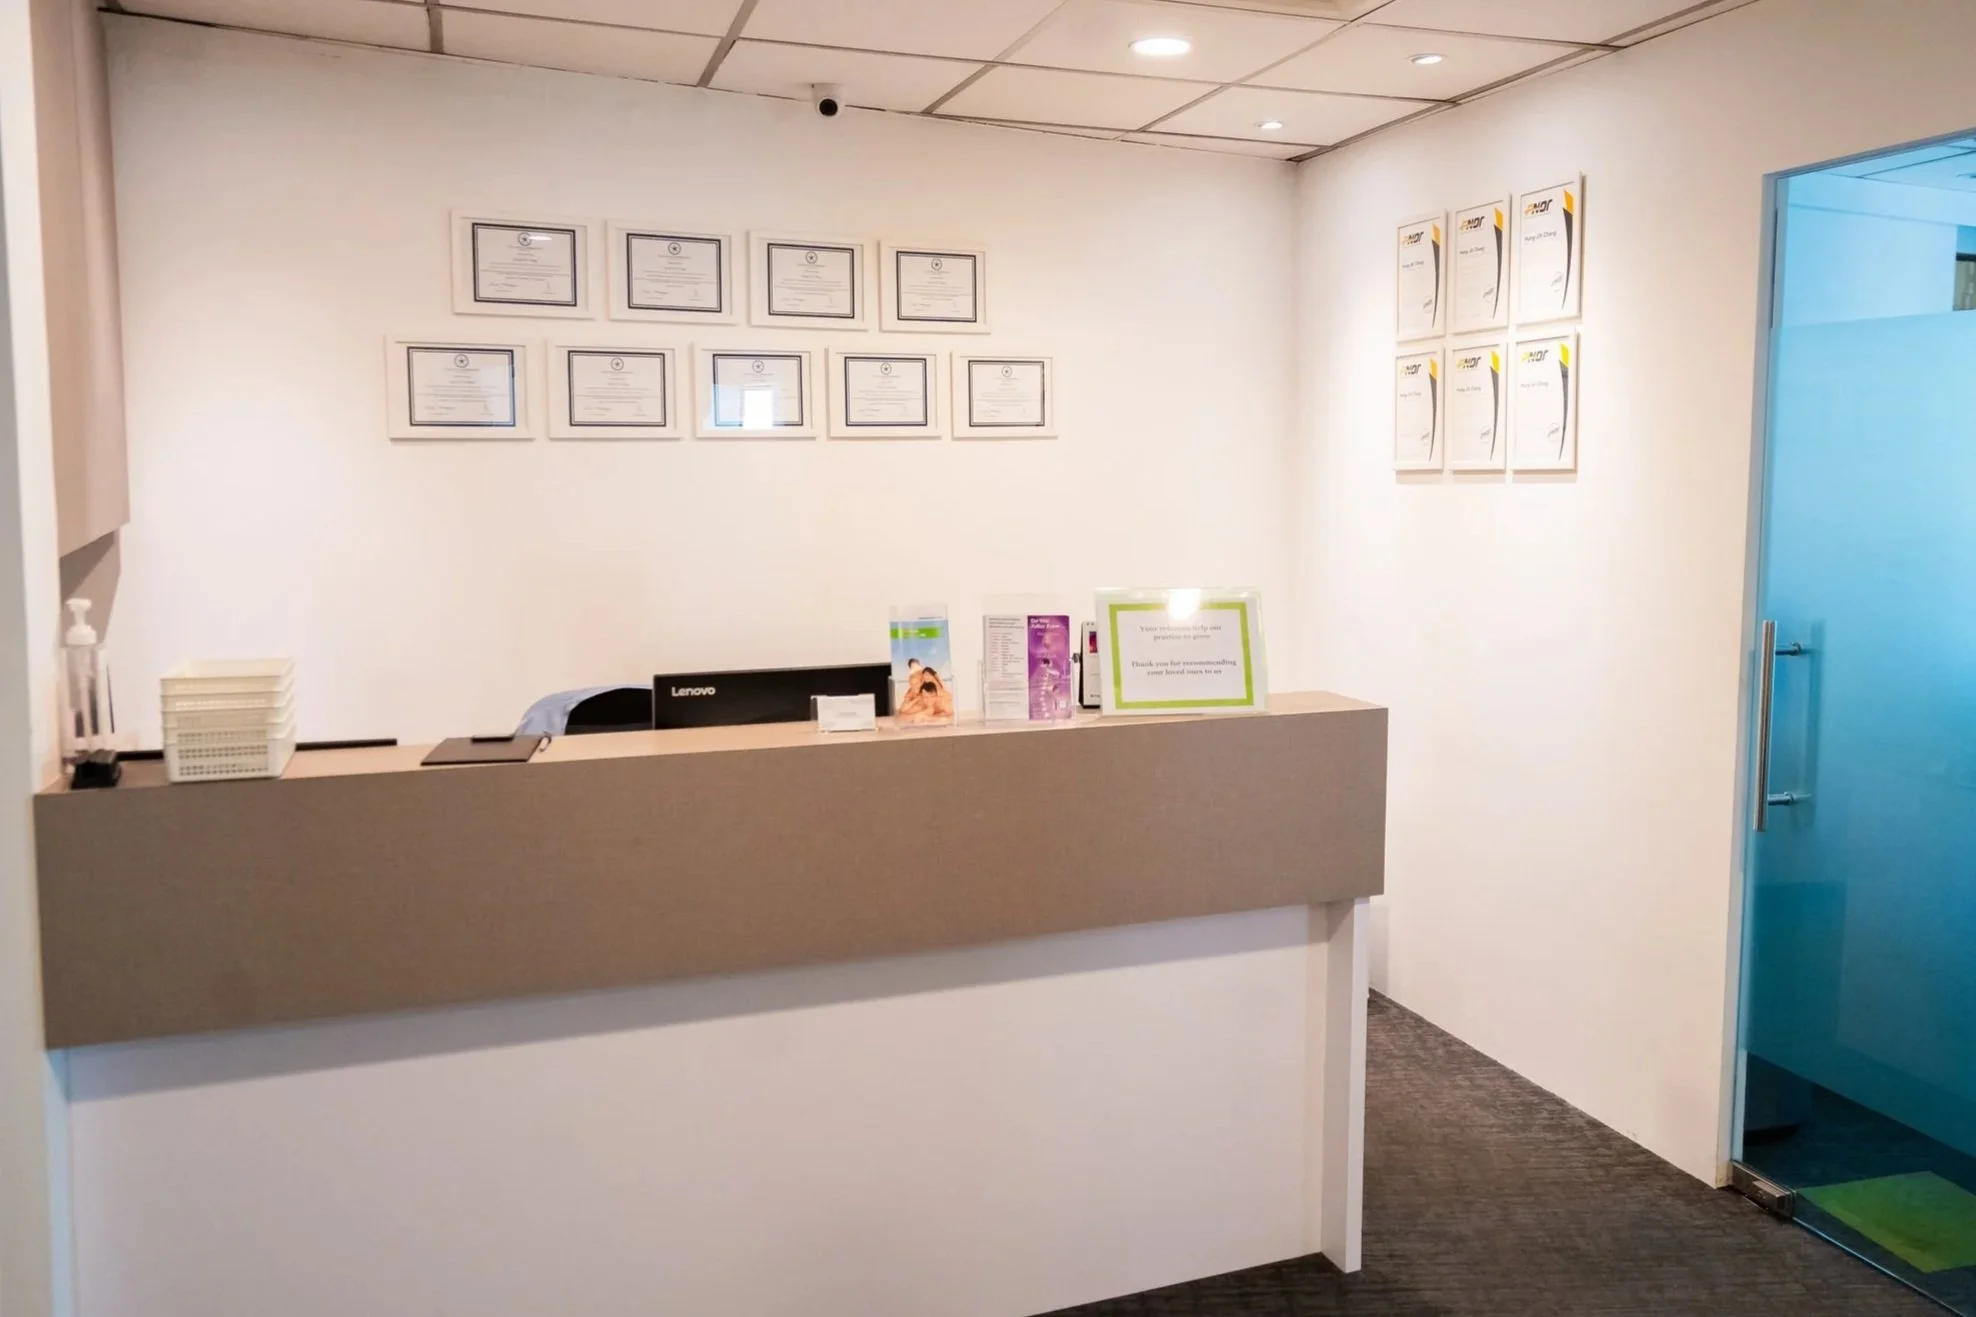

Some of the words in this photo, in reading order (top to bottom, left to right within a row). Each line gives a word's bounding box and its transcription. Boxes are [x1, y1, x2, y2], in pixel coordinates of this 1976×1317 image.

[1153, 633, 1182, 641] practice
[1132, 660, 1153, 668] Thank
[1182, 659, 1237, 667] recommending
[1147, 669, 1164, 677] your
[671, 686, 716, 697] Lenovo
